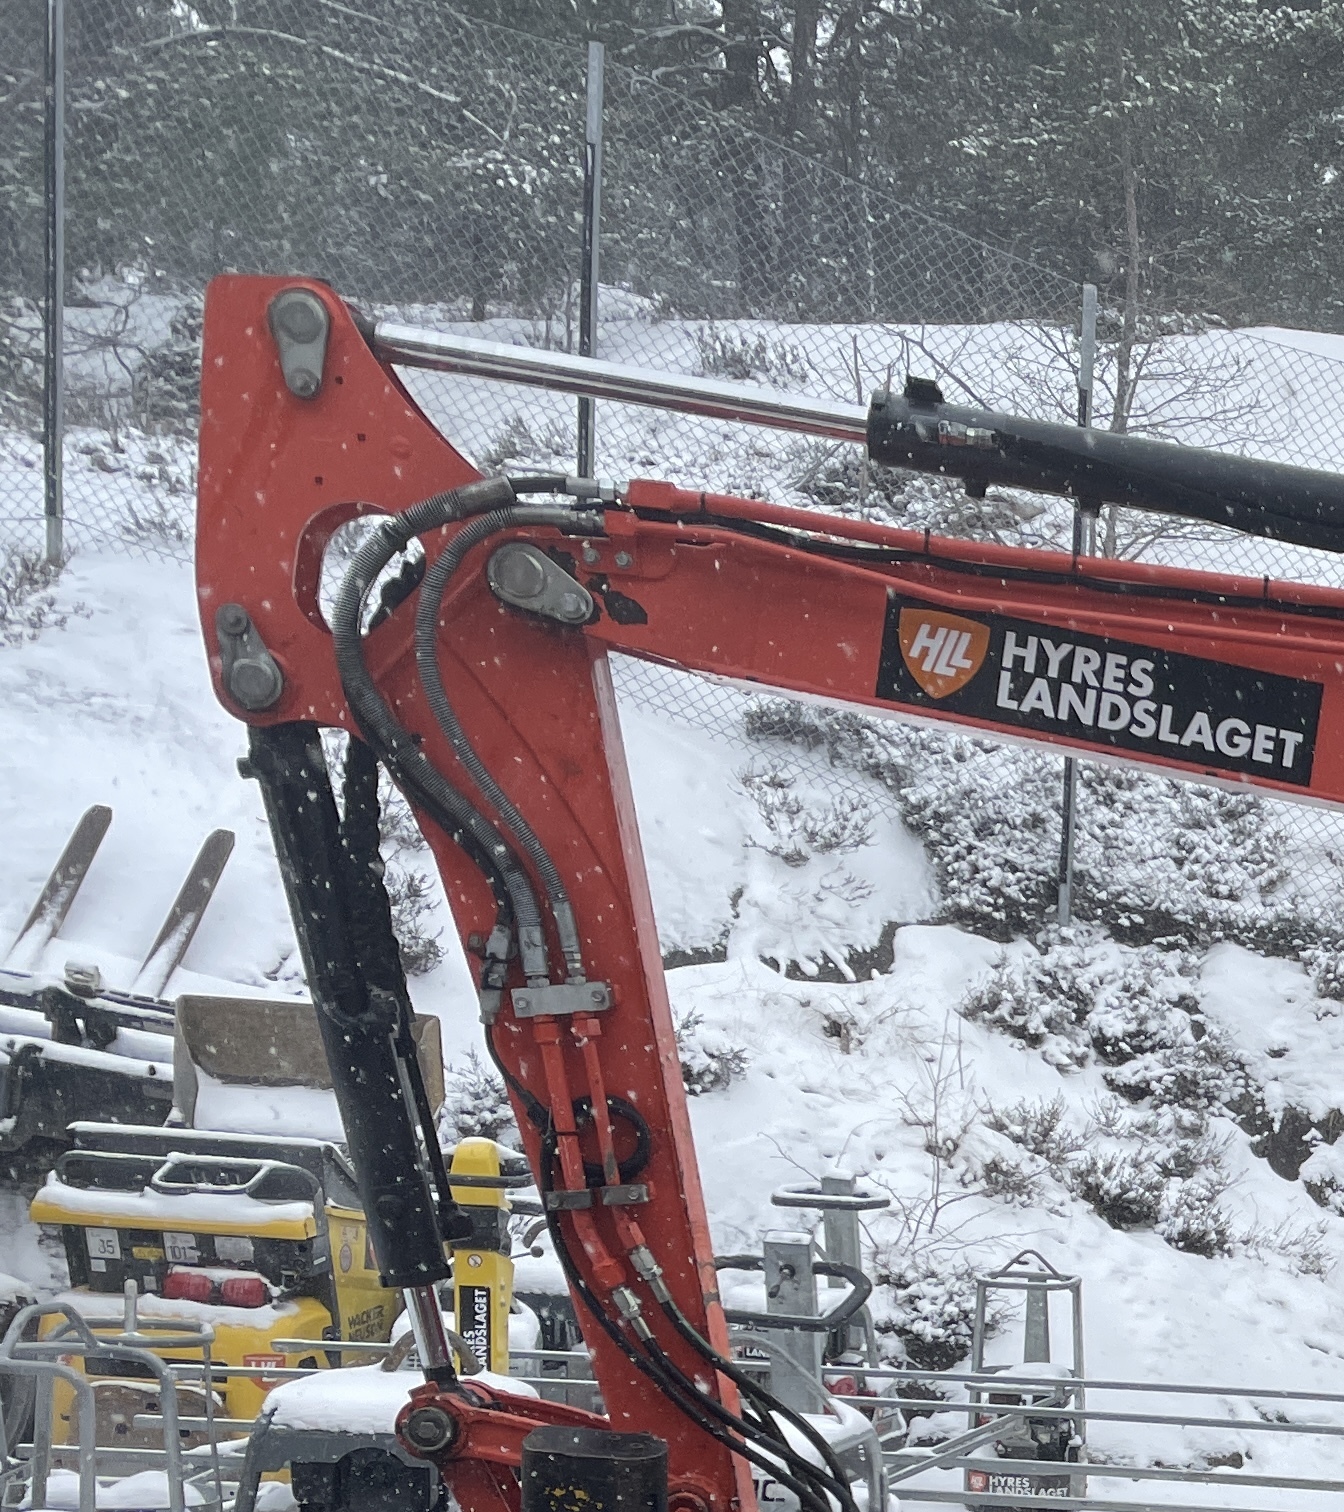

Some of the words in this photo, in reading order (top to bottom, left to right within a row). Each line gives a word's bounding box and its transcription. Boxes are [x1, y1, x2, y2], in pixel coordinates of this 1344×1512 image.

[1001, 630, 1155, 699] HYRES
[996, 671, 1304, 769] LANDSLAGET
[989, 1476, 1030, 1488] HYRES
[989, 1486, 1069, 1497] LANDSLAGET
